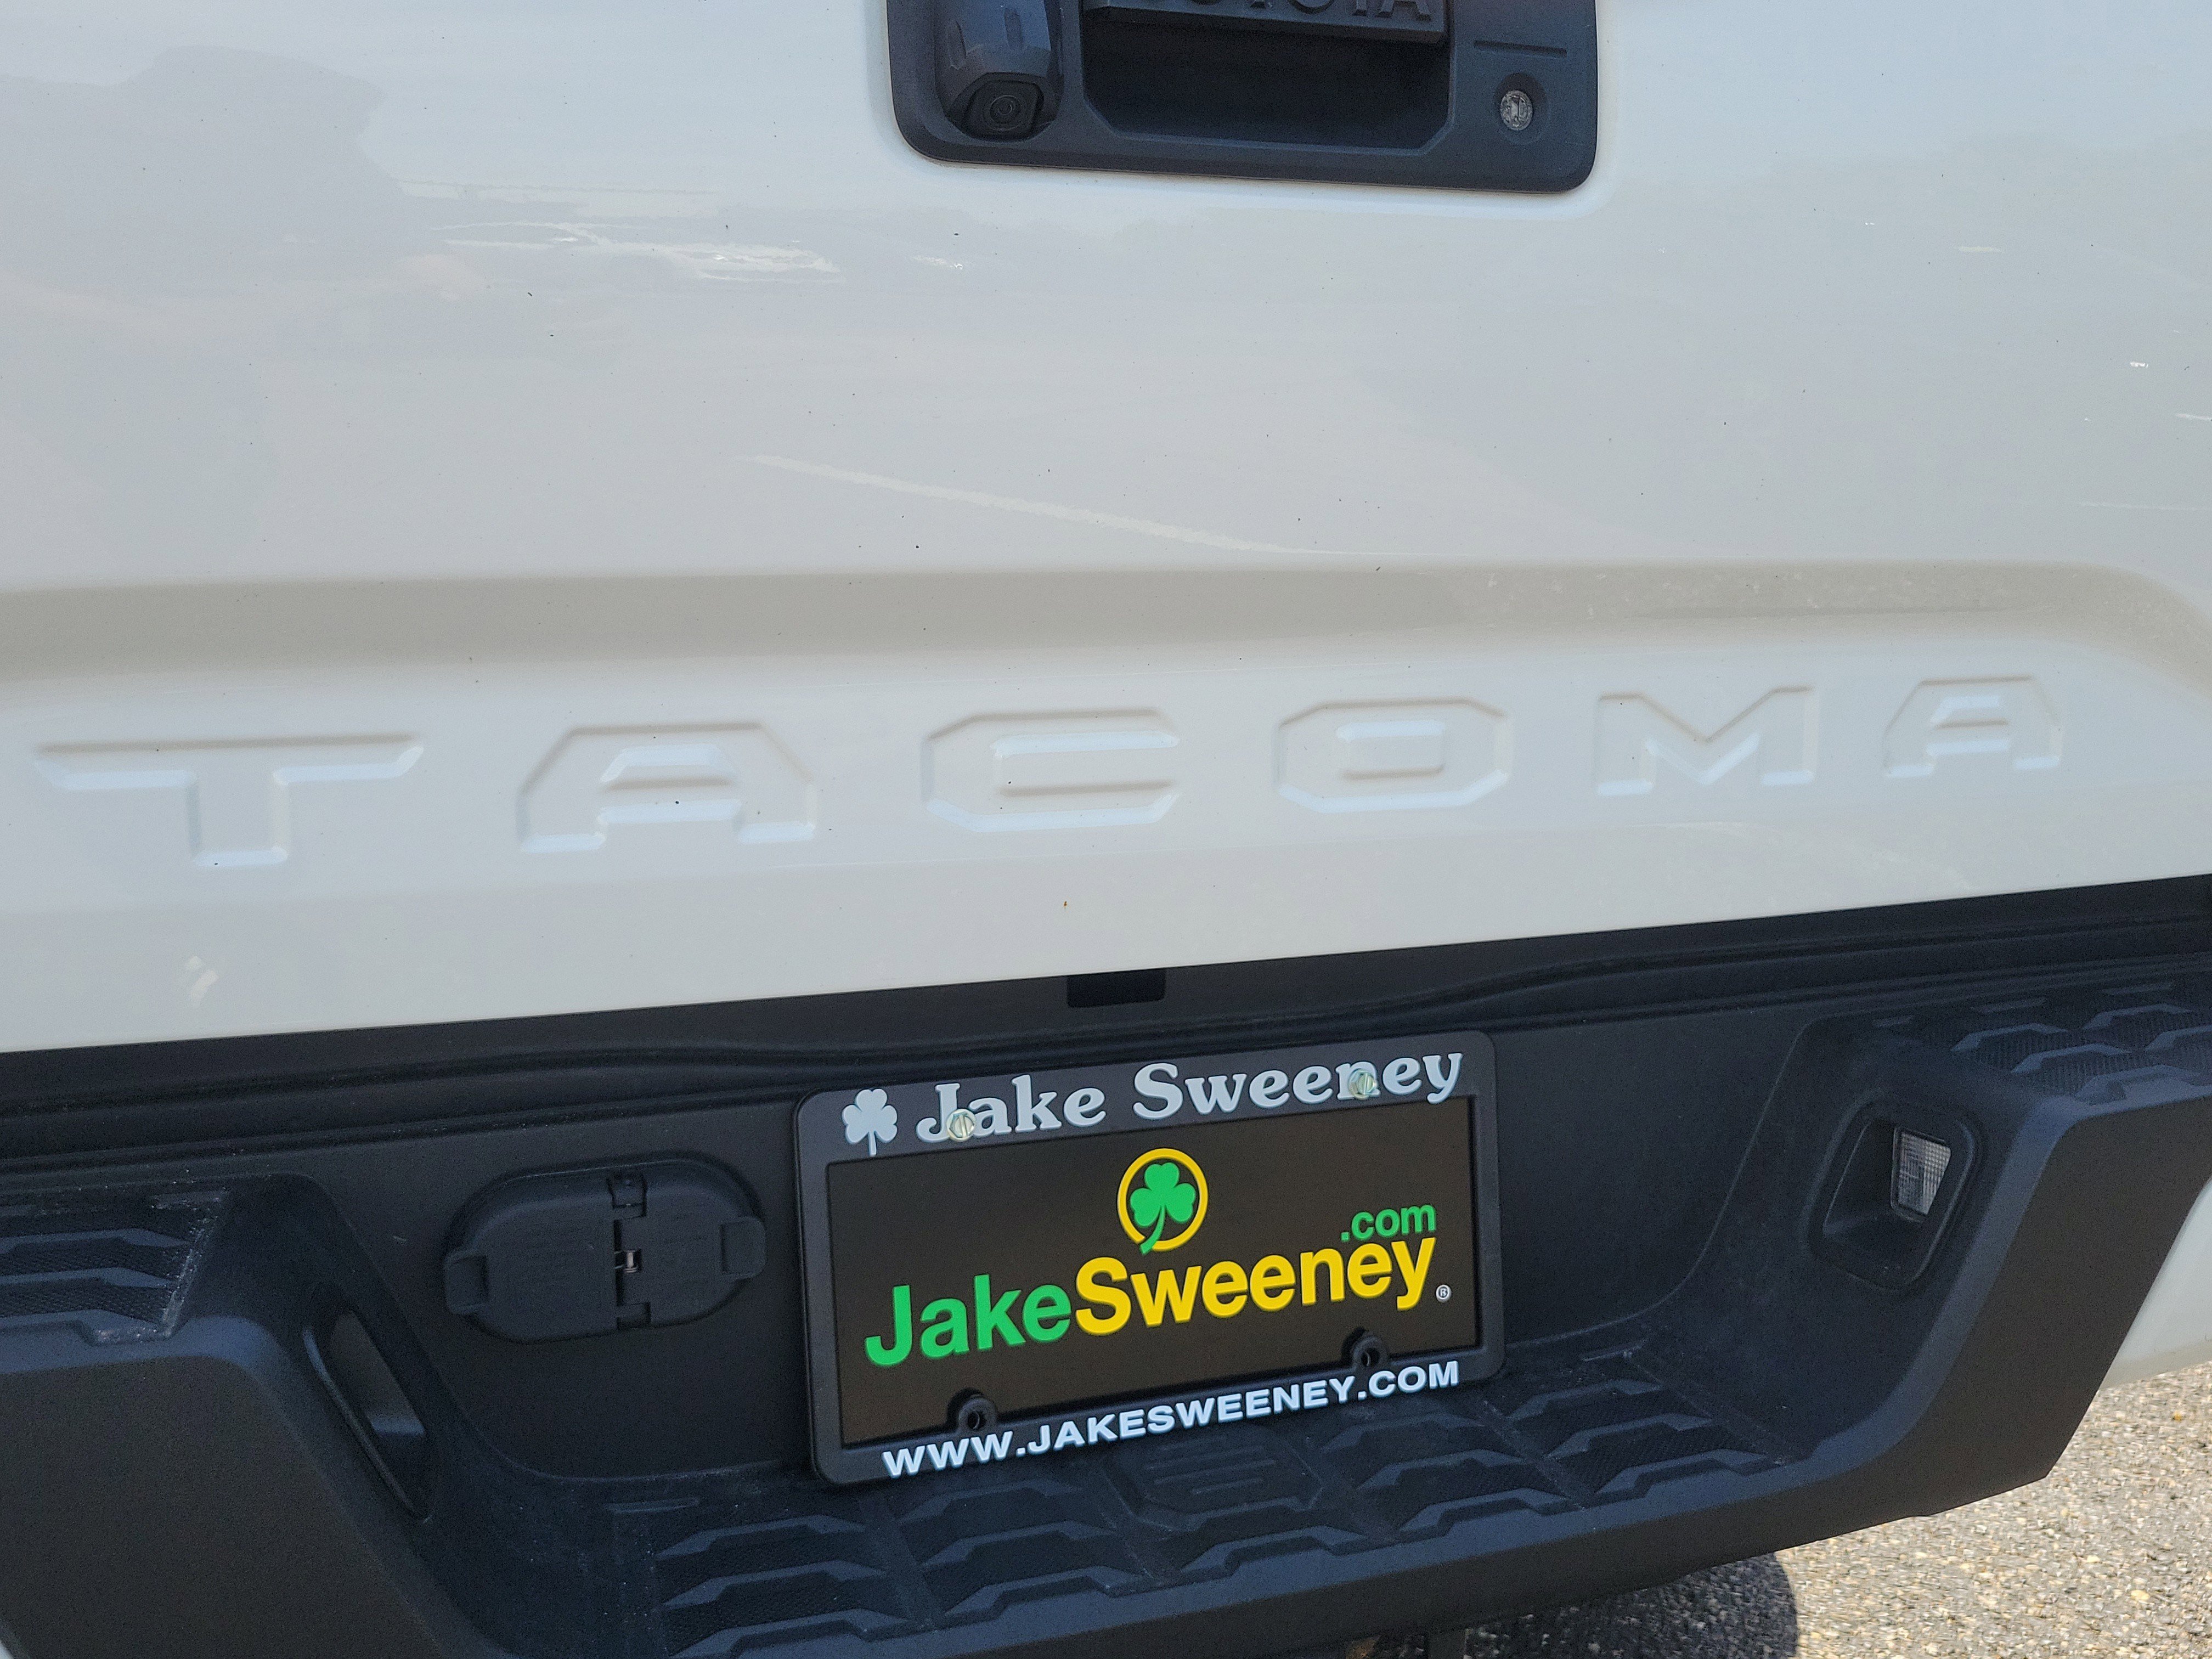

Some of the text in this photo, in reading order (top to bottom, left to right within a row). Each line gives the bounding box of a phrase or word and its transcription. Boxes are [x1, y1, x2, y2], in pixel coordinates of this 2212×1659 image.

[34, 675, 2065, 868] TACOMA
[916, 1053, 1463, 1143] Jake Sweeney
[1340, 1204, 1436, 1243] .com
[882, 1361, 1460, 1479] WWW.JAKESWEENEY.COM
